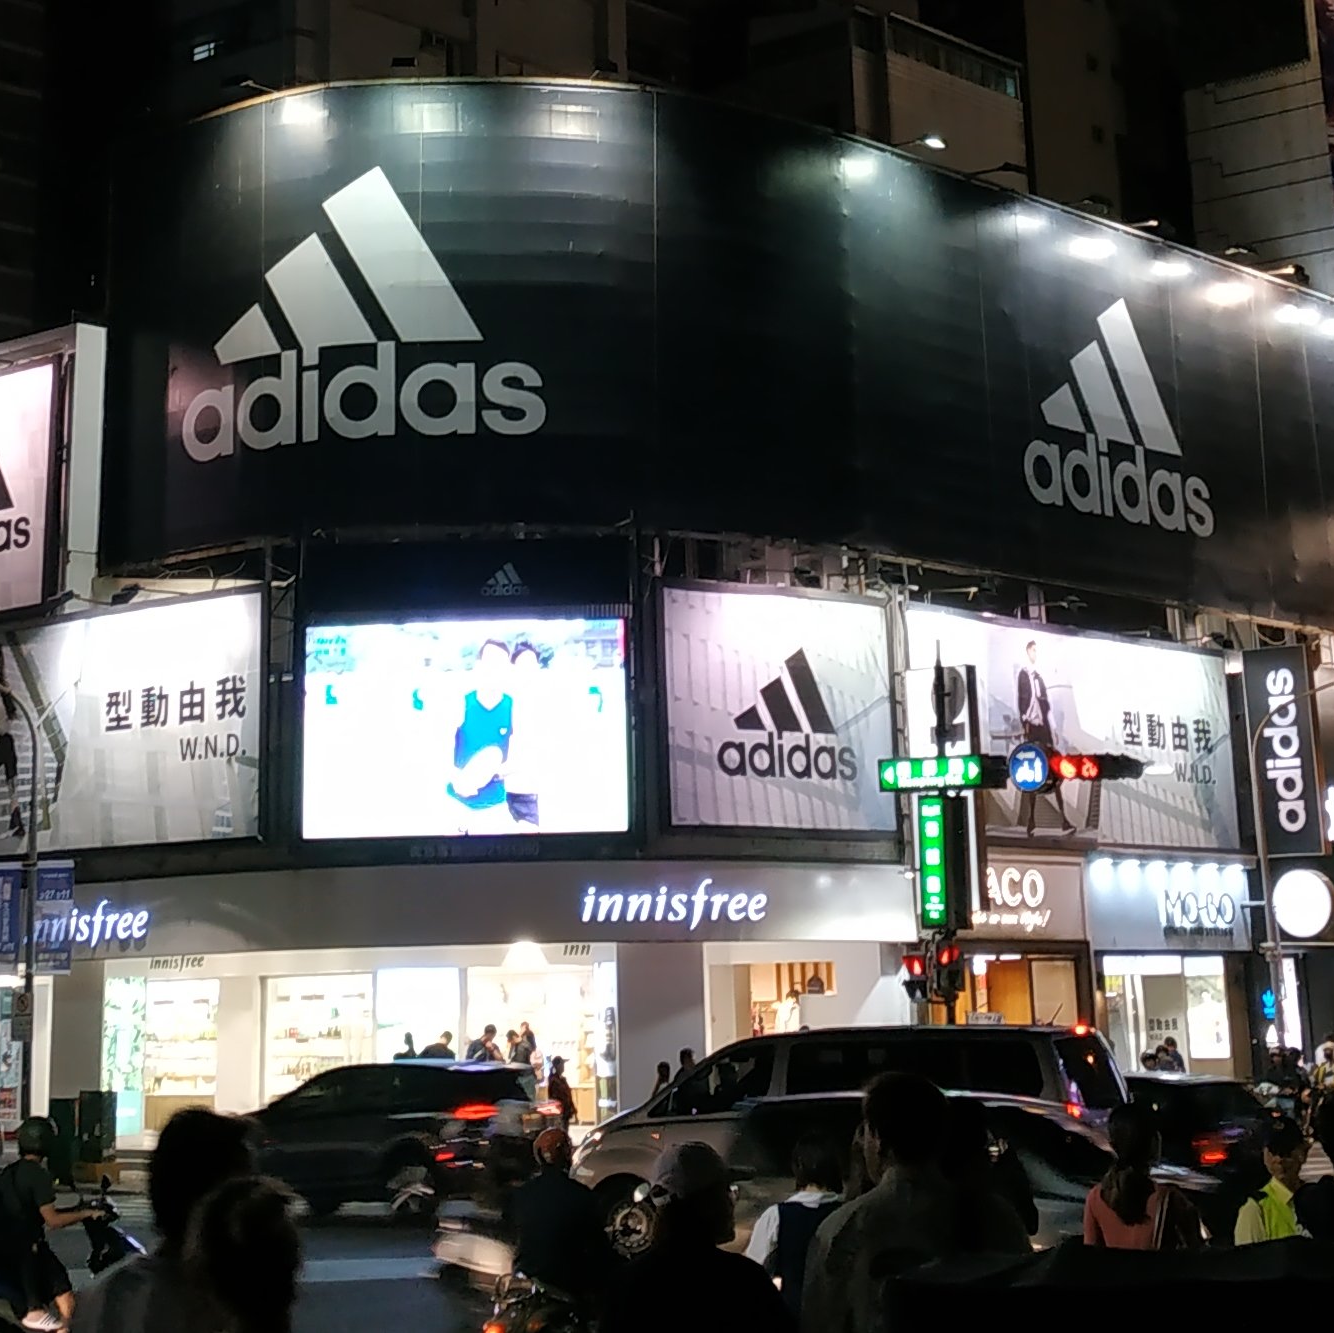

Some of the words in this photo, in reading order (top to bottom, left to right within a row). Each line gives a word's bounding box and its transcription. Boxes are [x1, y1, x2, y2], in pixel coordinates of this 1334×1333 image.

[181, 340, 547, 463] adidas
[1022, 431, 1217, 539] adidas
[480, 584, 529, 597] adidas
[104, 675, 248, 734] 型動由我
[179, 734, 248, 763] W.N.D.
[717, 728, 858, 781] adidas
[1121, 711, 1216, 754] 型動由我
[1263, 667, 1307, 833] adidas
[580, 879, 769, 931] innisfree
[150, 956, 205, 973] innisfree
